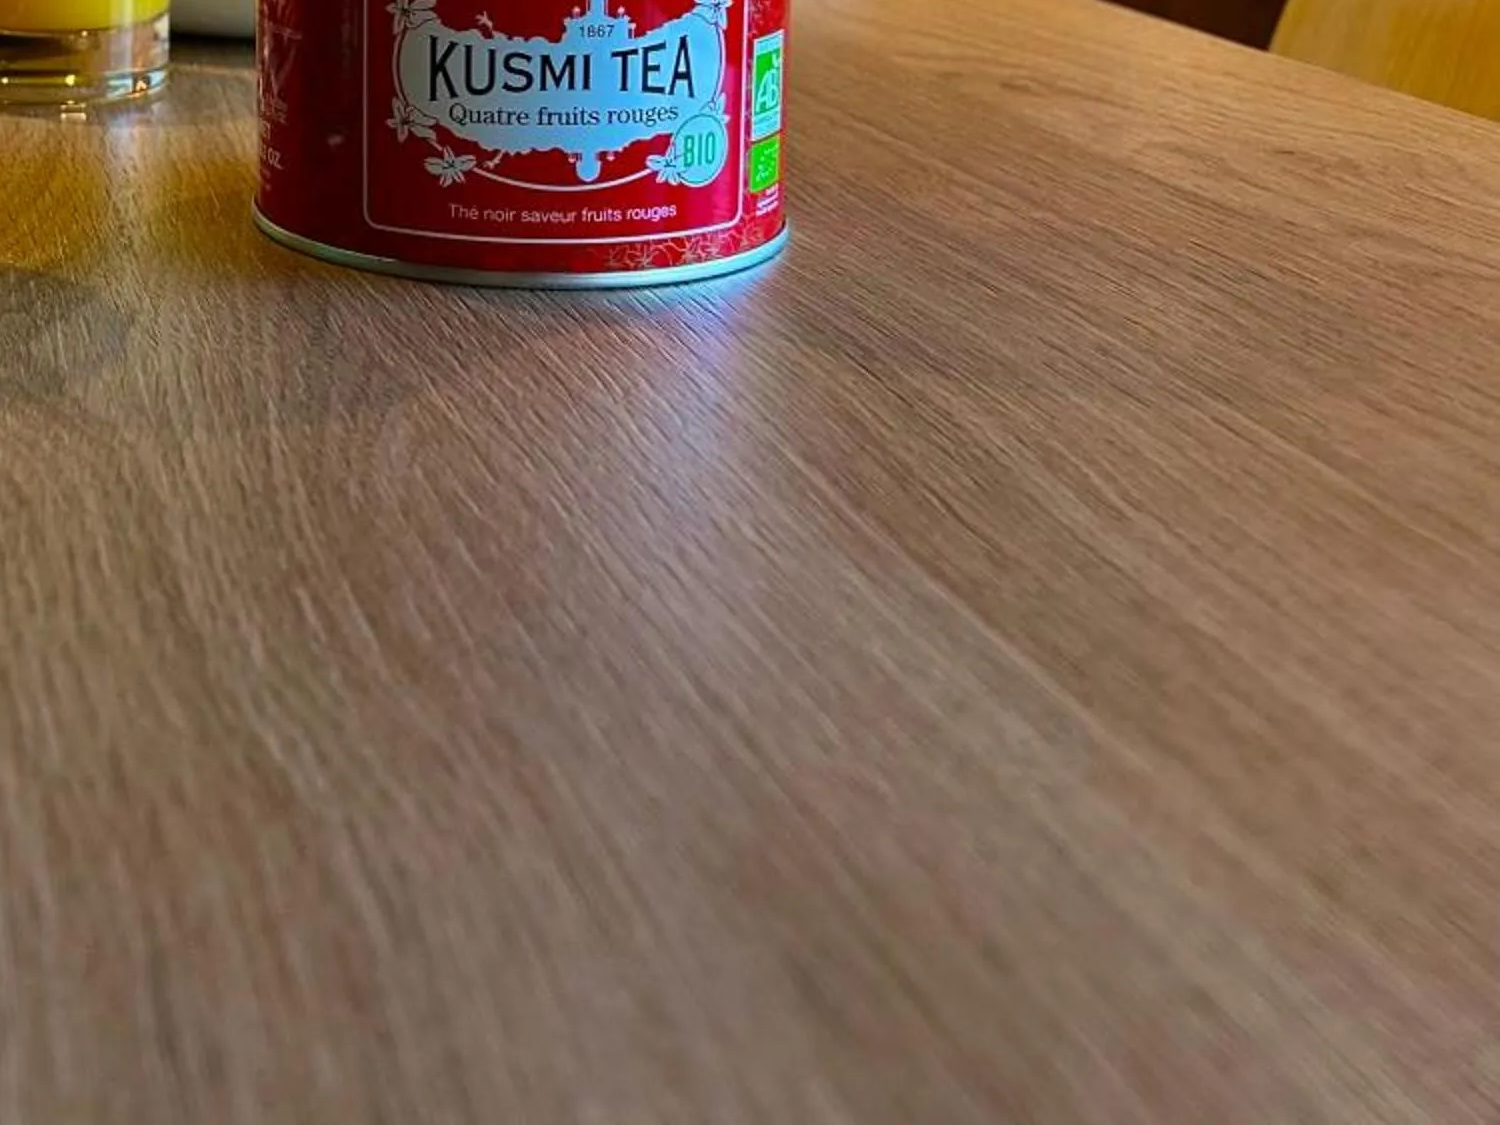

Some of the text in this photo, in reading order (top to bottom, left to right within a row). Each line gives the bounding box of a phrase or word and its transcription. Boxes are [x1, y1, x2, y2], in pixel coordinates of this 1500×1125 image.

[579, 24, 615, 38] 1867
[428, 34, 695, 102] KUSMI TEA
[449, 102, 679, 130] Quatre fruits rouges
[683, 131, 716, 168] BIO
[449, 203, 677, 224] Thé noir saveur fruits rouges
